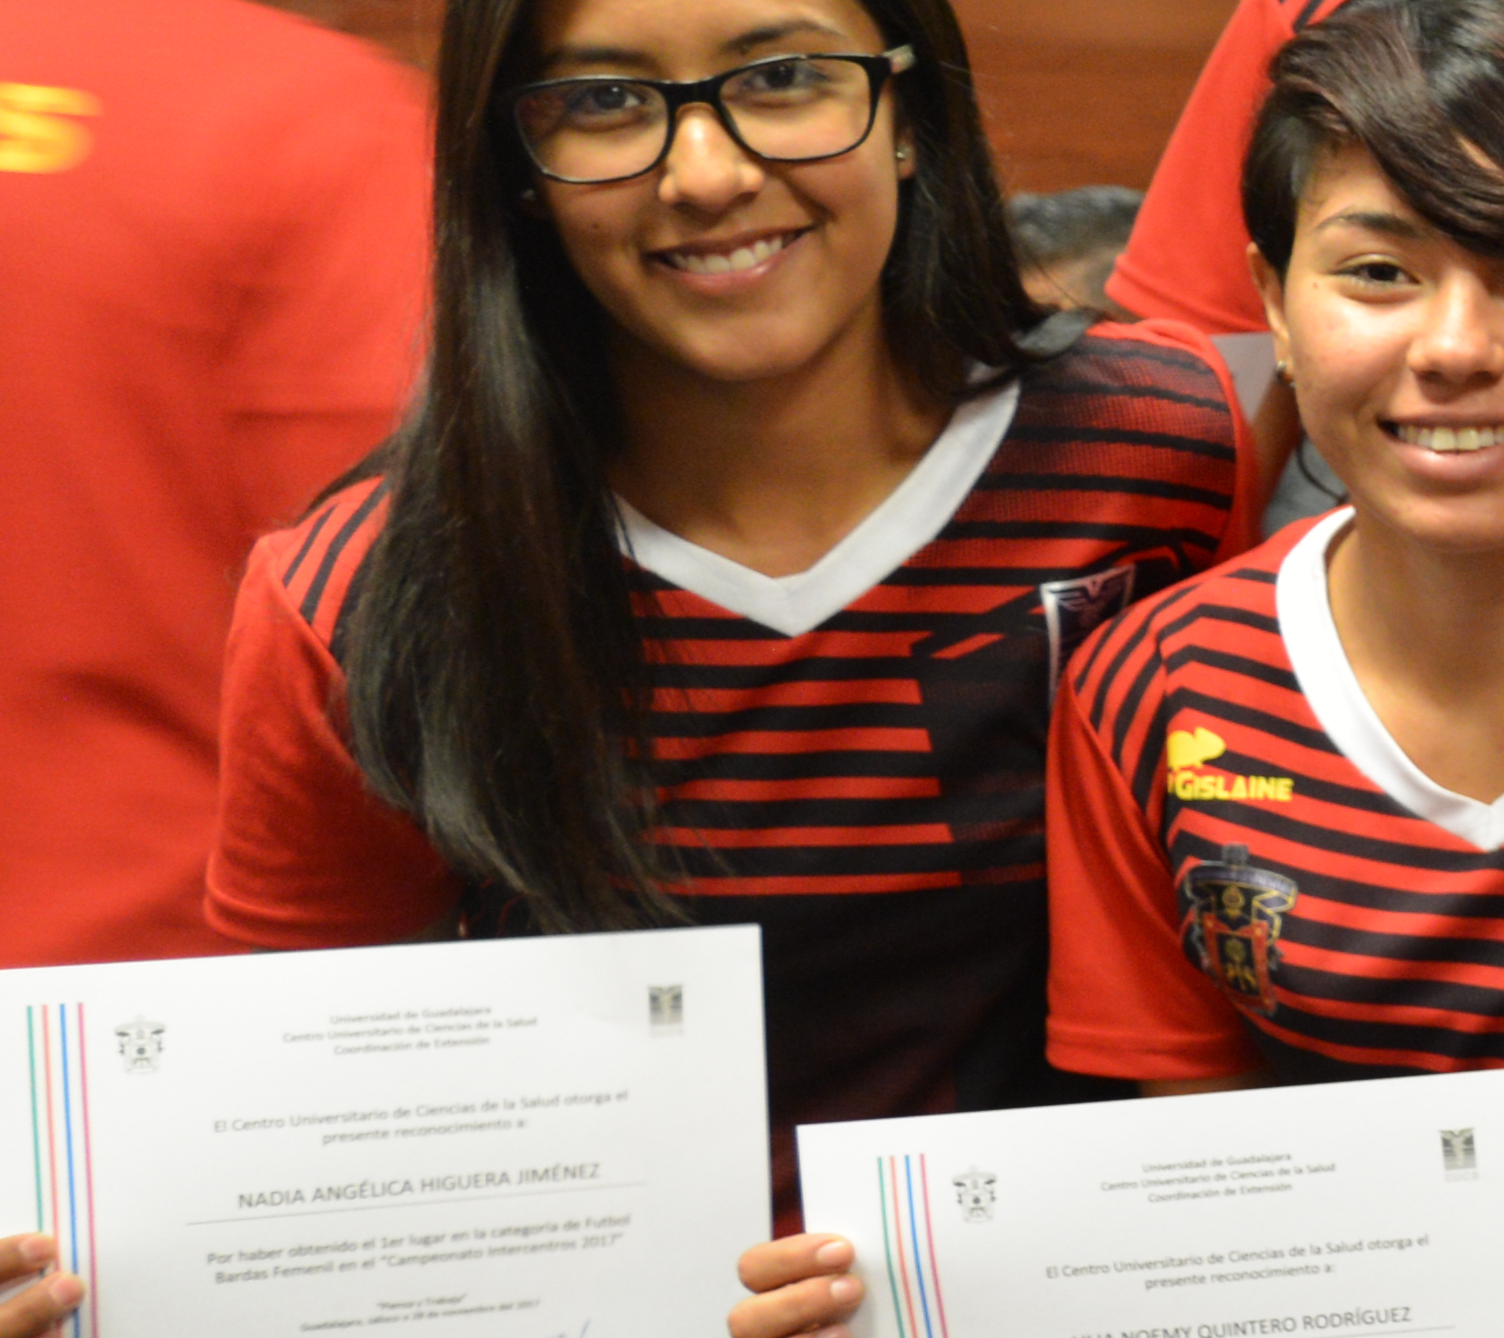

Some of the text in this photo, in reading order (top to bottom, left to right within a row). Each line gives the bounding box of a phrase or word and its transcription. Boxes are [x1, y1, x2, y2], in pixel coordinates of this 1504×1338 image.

[1175, 770, 1294, 801] GISLAINE
[237, 1162, 599, 1208] NADIA ANGÉLICA HIGUERA JIMÉNEZ
[1045, 1233, 1430, 1279] El Centro Universitario de Ciencias de la Salud otorga el
[1144, 1263, 1334, 1291] presente reconocimiento a:
[1301, 1306, 1411, 1330] RODRÍGUEZ
